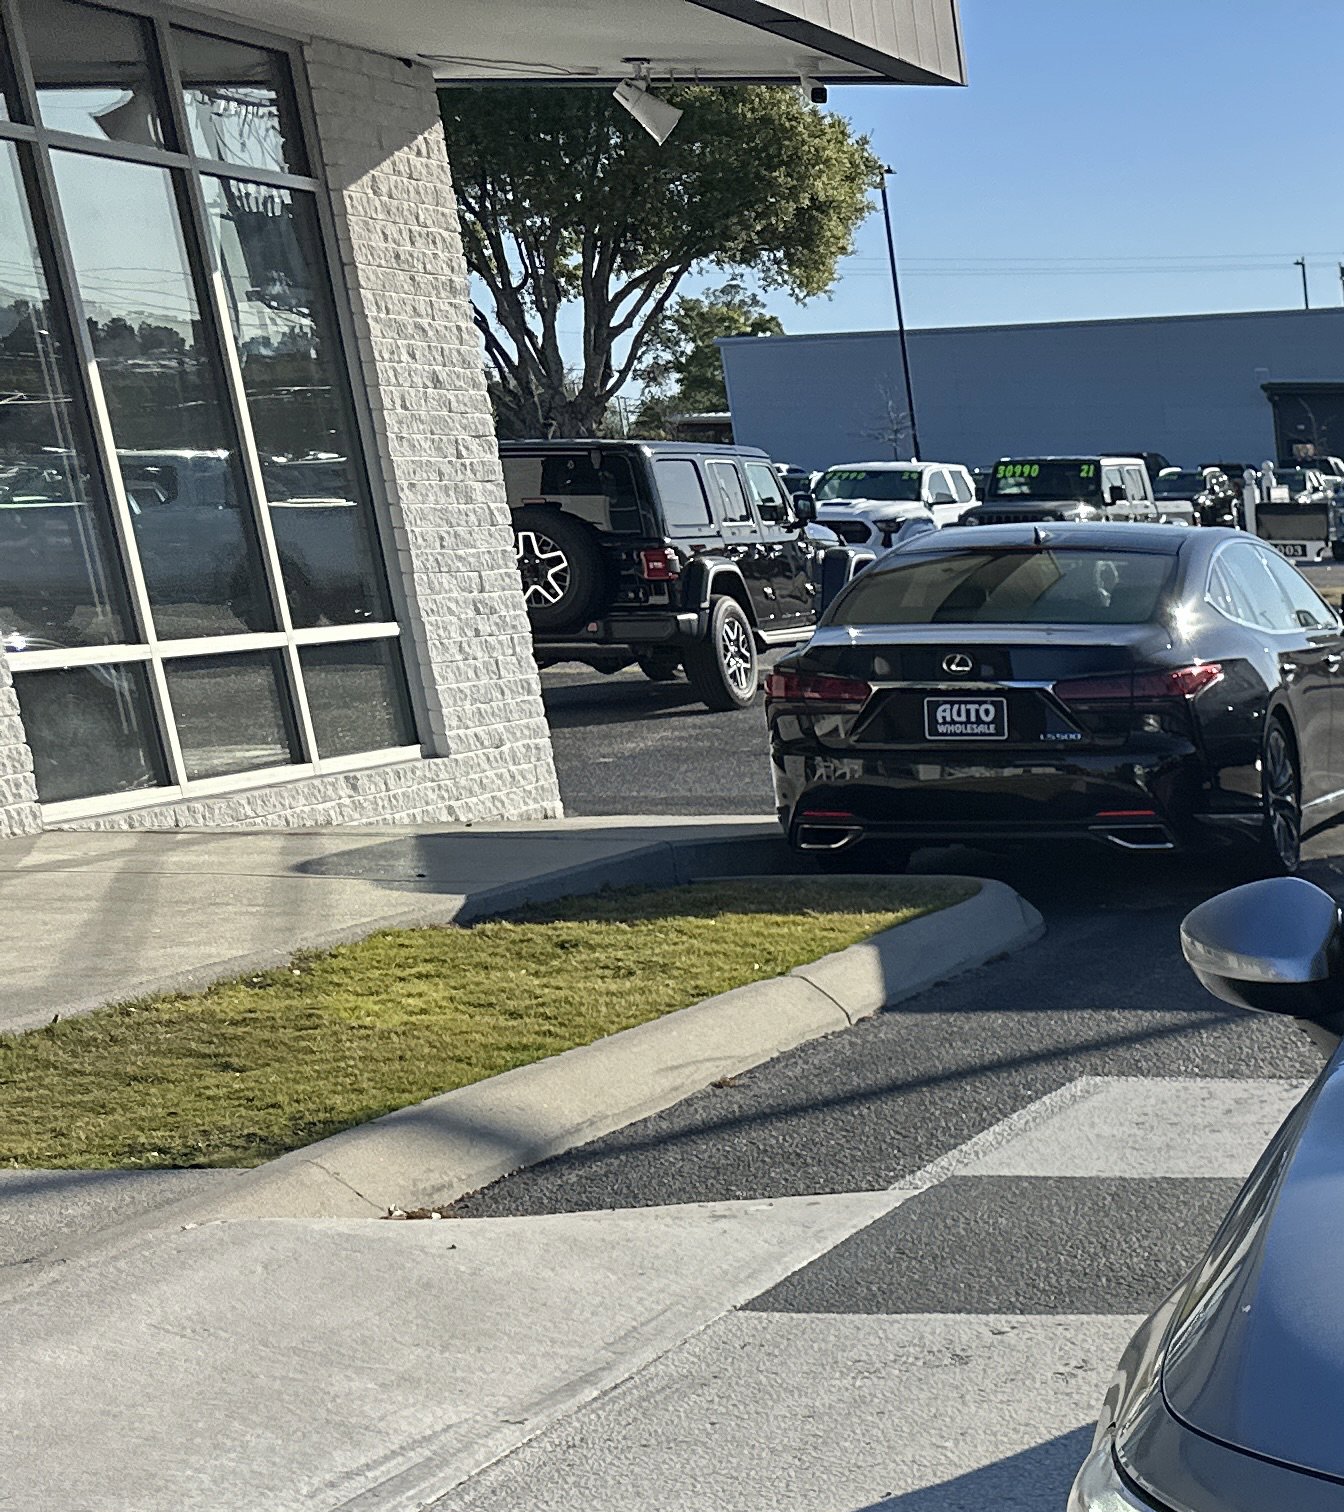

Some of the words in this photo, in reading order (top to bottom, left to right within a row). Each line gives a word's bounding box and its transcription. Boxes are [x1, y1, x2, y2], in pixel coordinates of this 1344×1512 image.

[1080, 464, 1095, 478] 21
[936, 703, 995, 723] AUTO
[937, 724, 996, 734] WHOLESALE
